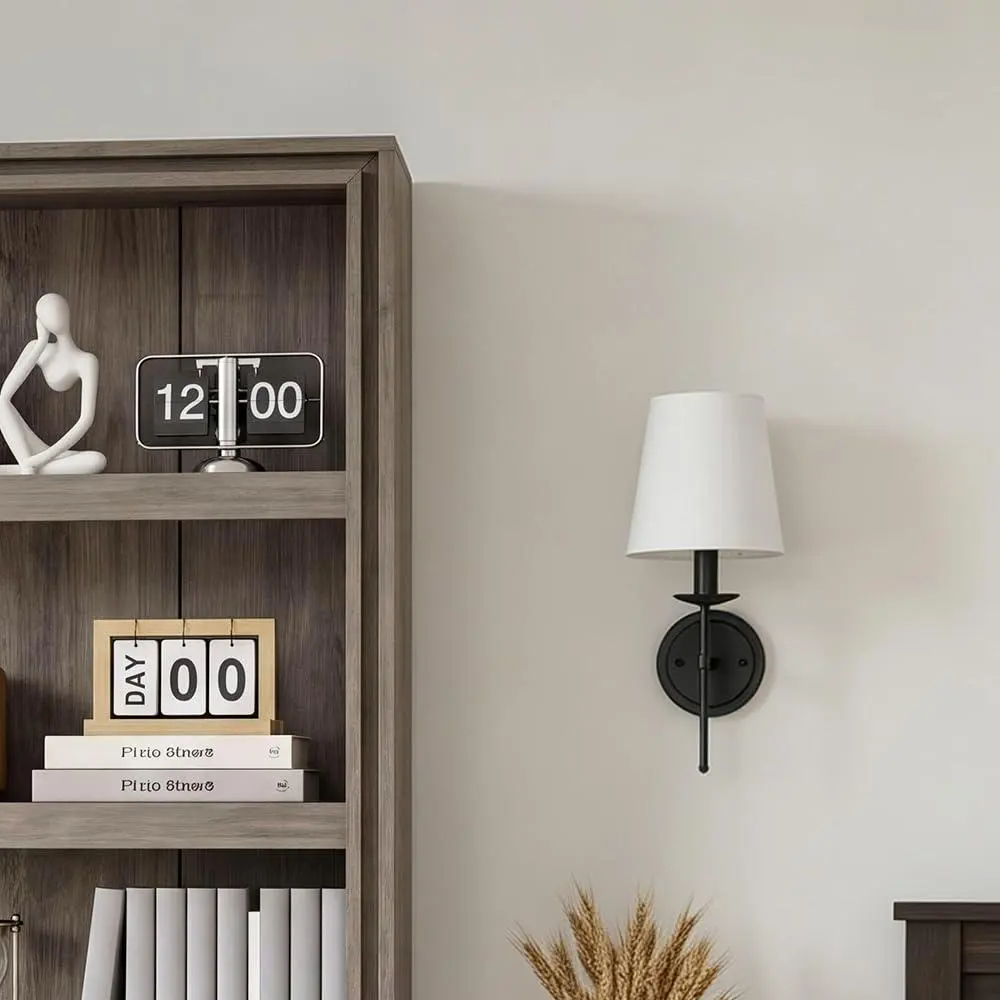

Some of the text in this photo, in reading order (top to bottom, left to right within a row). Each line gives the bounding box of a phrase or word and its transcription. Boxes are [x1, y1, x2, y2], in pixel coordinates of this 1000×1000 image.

[157, 381, 303, 421] 12 00
[125, 654, 146, 706] DAY
